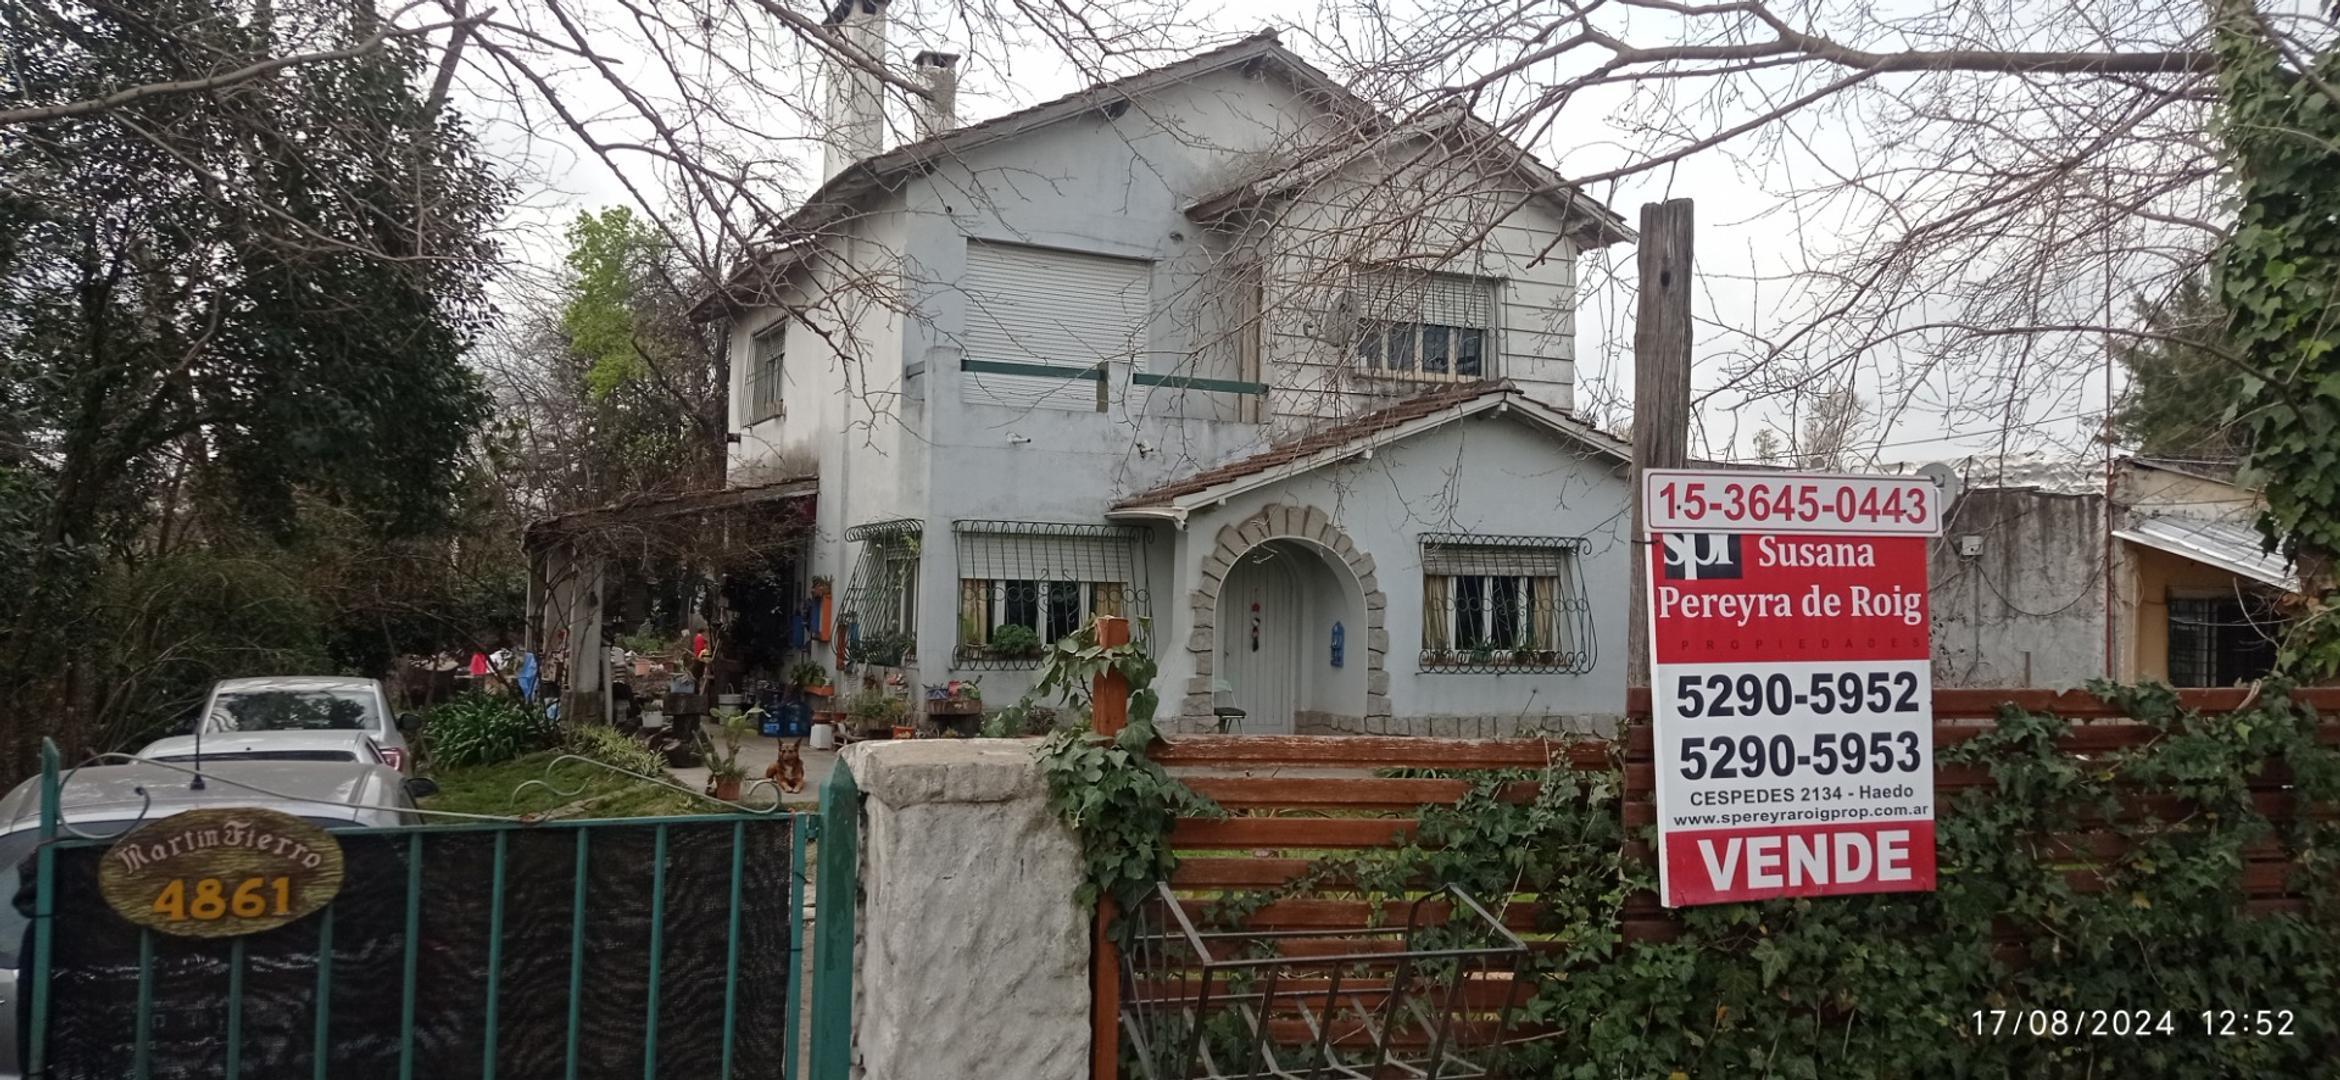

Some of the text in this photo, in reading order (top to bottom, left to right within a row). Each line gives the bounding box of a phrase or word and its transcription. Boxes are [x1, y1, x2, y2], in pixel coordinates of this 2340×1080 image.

[1659, 482, 1927, 525] 15-3645-0443
[1758, 536, 1875, 568] Susana
[1658, 584, 1922, 627] Pereyra de Roig
[1677, 671, 1919, 719] 5290-5952
[1679, 731, 1921, 780] 5290-5953
[1673, 804, 1929, 827] www.spereyraroigprop.com.ar
[1690, 788, 1795, 807] CESPEDES
[1801, 786, 1842, 802] 2134
[1859, 784, 1914, 800] Haedo
[115, 820, 323, 875] Martin Fierro
[1697, 829, 1912, 892] VENDE
[152, 876, 292, 921] 4861
